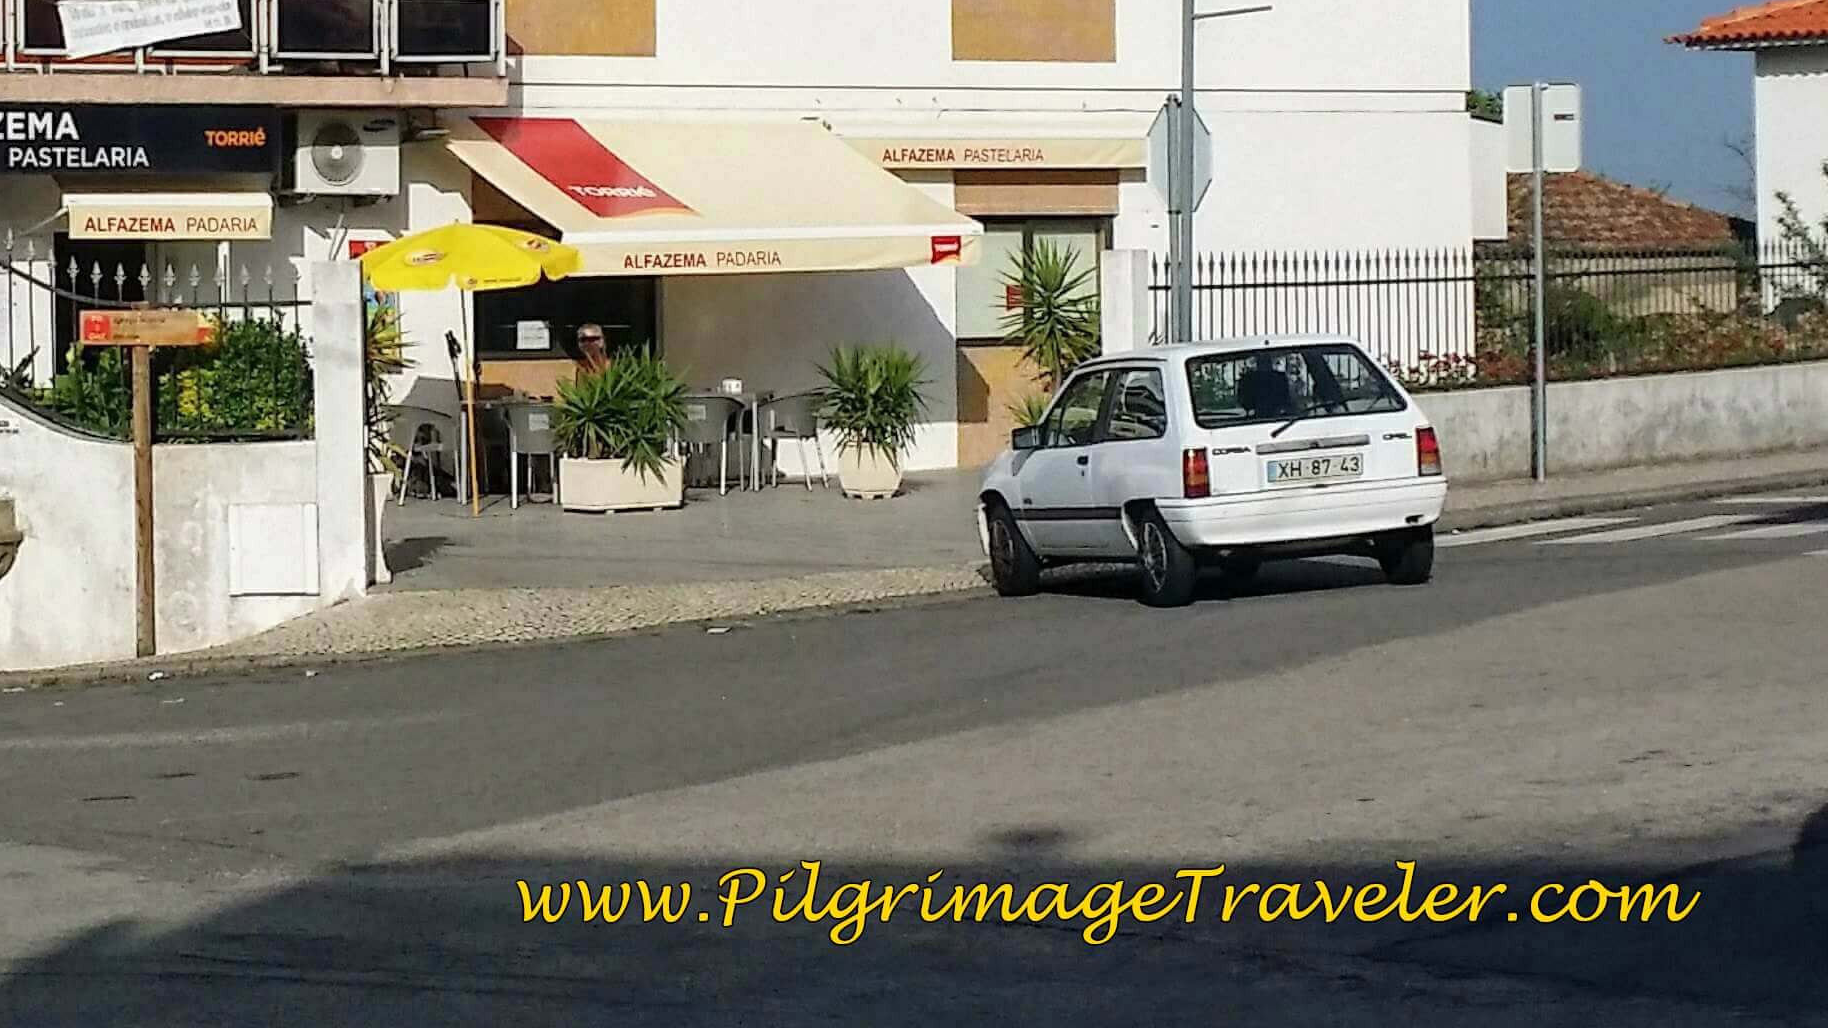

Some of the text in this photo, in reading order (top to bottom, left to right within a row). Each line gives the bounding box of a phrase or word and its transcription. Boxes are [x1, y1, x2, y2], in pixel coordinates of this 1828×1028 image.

[9, 146, 150, 168] PASTELARIA
[882, 148, 1045, 163] ALFAZEMA PASTELARIA
[84, 217, 258, 233] ALFAZEMA PADARIA
[624, 251, 781, 269] ALFAZEMA PADARIA
